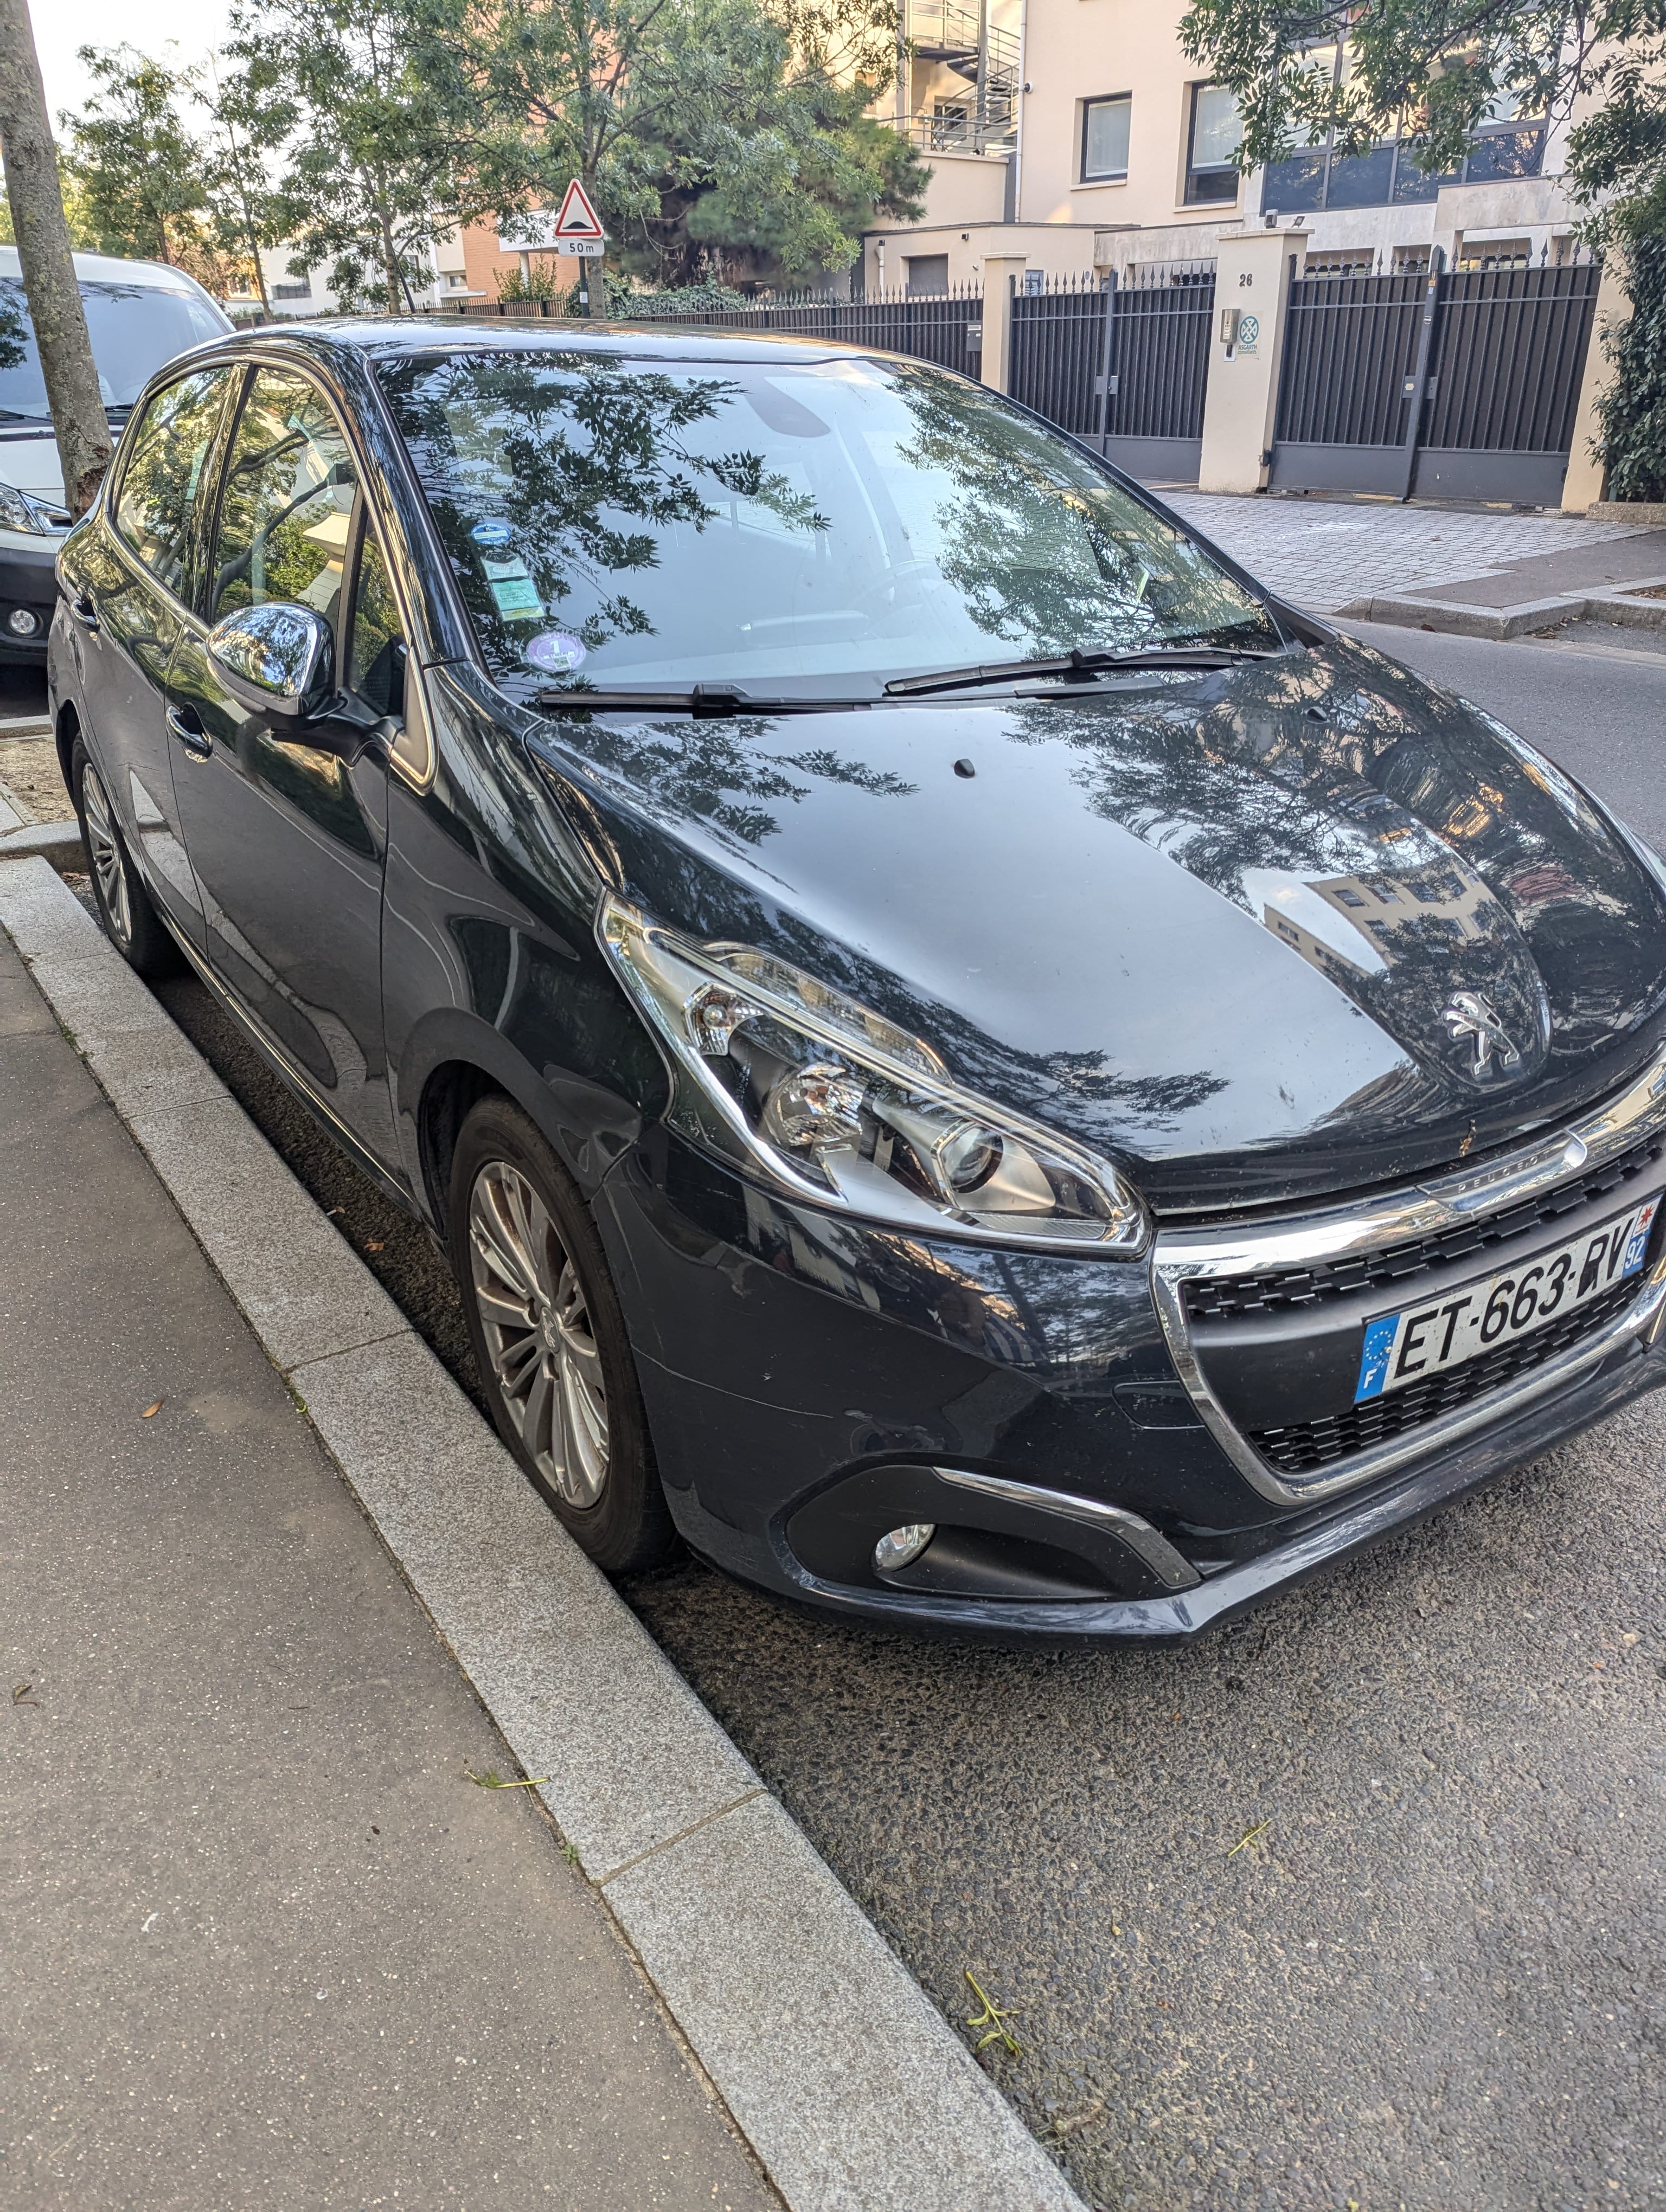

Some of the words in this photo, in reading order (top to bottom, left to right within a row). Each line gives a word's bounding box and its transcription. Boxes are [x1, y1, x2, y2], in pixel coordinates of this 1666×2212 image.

[1239, 273, 1253, 287] 26
[1458, 1150, 1549, 1193] PEUGEOT
[1625, 1236, 1645, 1269] 92
[1393, 1217, 1635, 1379] ET-663-RV
[1363, 1368, 1377, 1389] F
